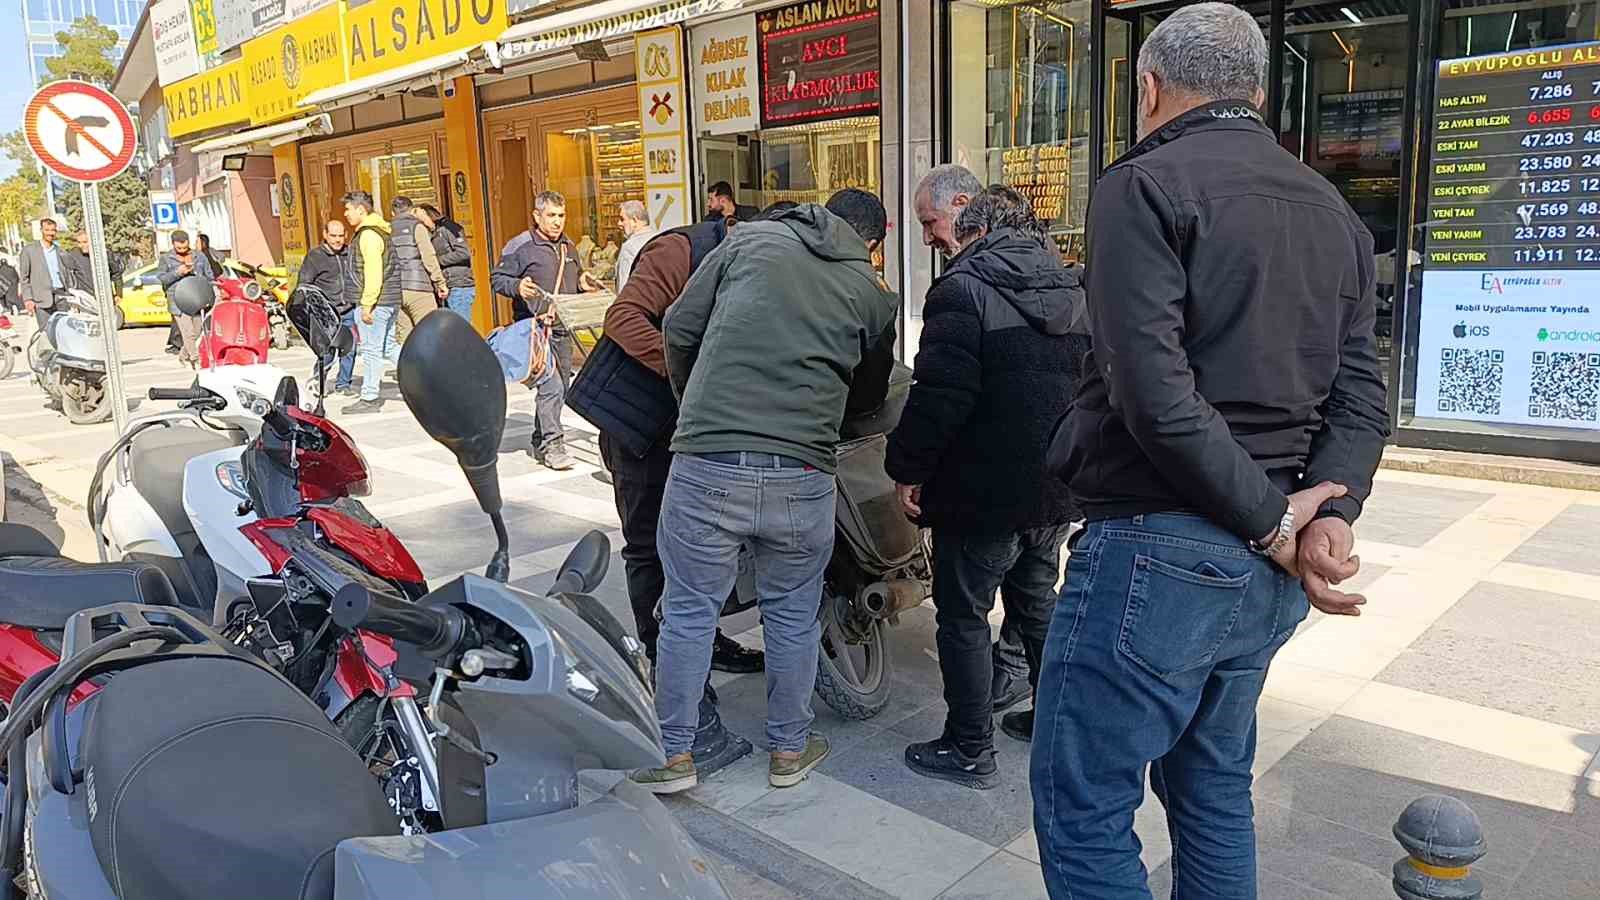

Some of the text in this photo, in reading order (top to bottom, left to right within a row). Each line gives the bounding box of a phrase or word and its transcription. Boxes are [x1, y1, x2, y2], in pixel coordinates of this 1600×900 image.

[775, 0, 861, 30] ASLAN AVCI
[351, 0, 494, 66] ALSADO
[303, 32, 338, 64] NABHAN
[701, 36, 748, 65] AĞRISIZ
[802, 33, 849, 62] AVCI
[1450, 47, 1600, 74] EYYUPOGLU AL
[706, 66, 747, 93] KULAK
[1542, 70, 1562, 80] ALIŞ
[165, 71, 241, 123] NABHAN
[1439, 81, 1600, 108] HAS ALTIN 7.286 7
[704, 93, 752, 122] DELİNİR
[1209, 106, 1263, 120] LACO
[1438, 105, 1600, 130] 22 AYAR BİLEZİK 6.655 6
[1437, 129, 1600, 152] ESKİ TAM 47.203 48
[1435, 154, 1600, 174] ESKİ YARIM 23.580 24
[1455, 185, 1490, 196] ÇEYREK
[1519, 179, 1570, 194] 11.825
[1580, 178, 1600, 191] 12
[157, 204, 174, 223] D
[1433, 202, 1600, 218] YENİ TAM 47.569 48.
[1432, 225, 1600, 239] YENİ YARIM 23.783 24.
[1430, 251, 1451, 262] YENİ
[1452, 252, 1488, 263] ÇEYREK
[1513, 249, 1563, 262] 11.911
[1455, 304, 1590, 314] Mobil Uygulamamız Yayında
[1469, 325, 1490, 337] iOS
